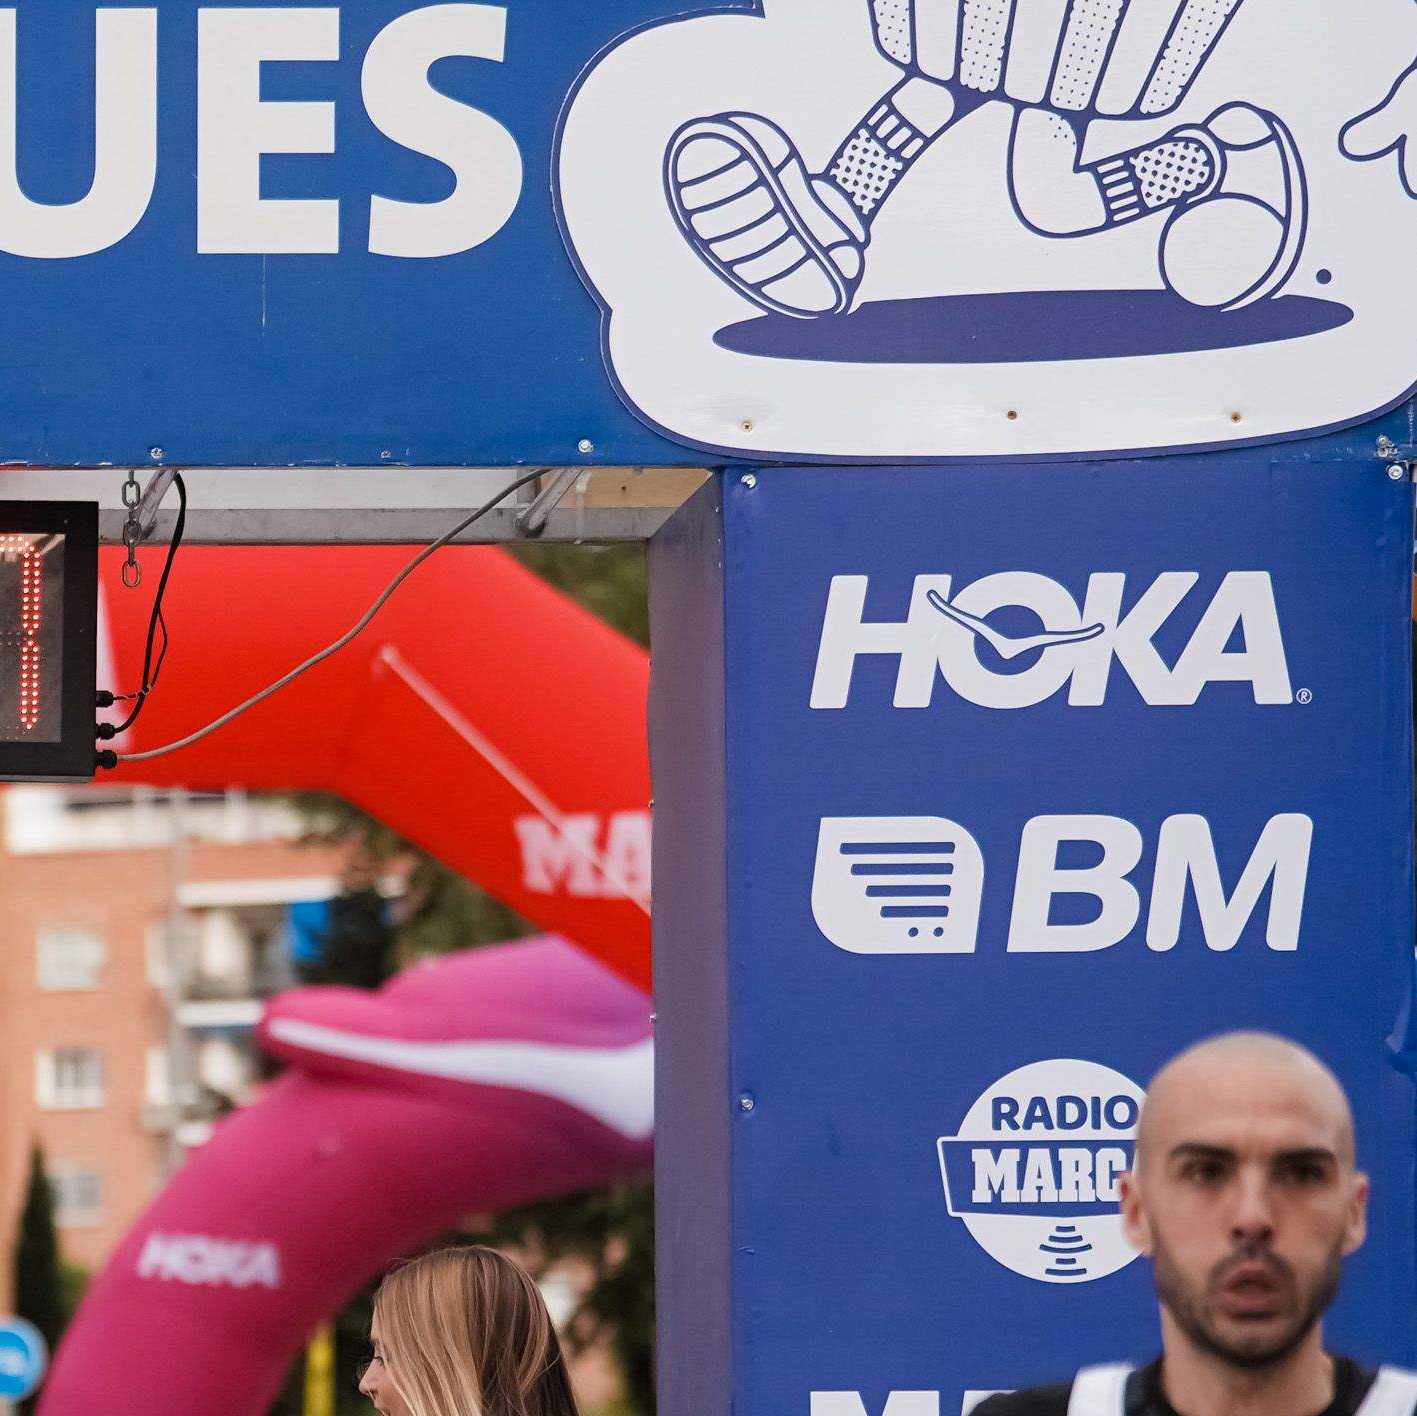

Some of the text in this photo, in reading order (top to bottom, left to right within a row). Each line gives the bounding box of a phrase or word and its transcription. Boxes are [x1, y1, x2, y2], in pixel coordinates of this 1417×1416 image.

[1007, 813, 1314, 952] BM
[991, 1094, 1140, 1131] RADIO
[971, 1148, 1139, 1203] MARC
[136, 1233, 280, 1291] HOKA
